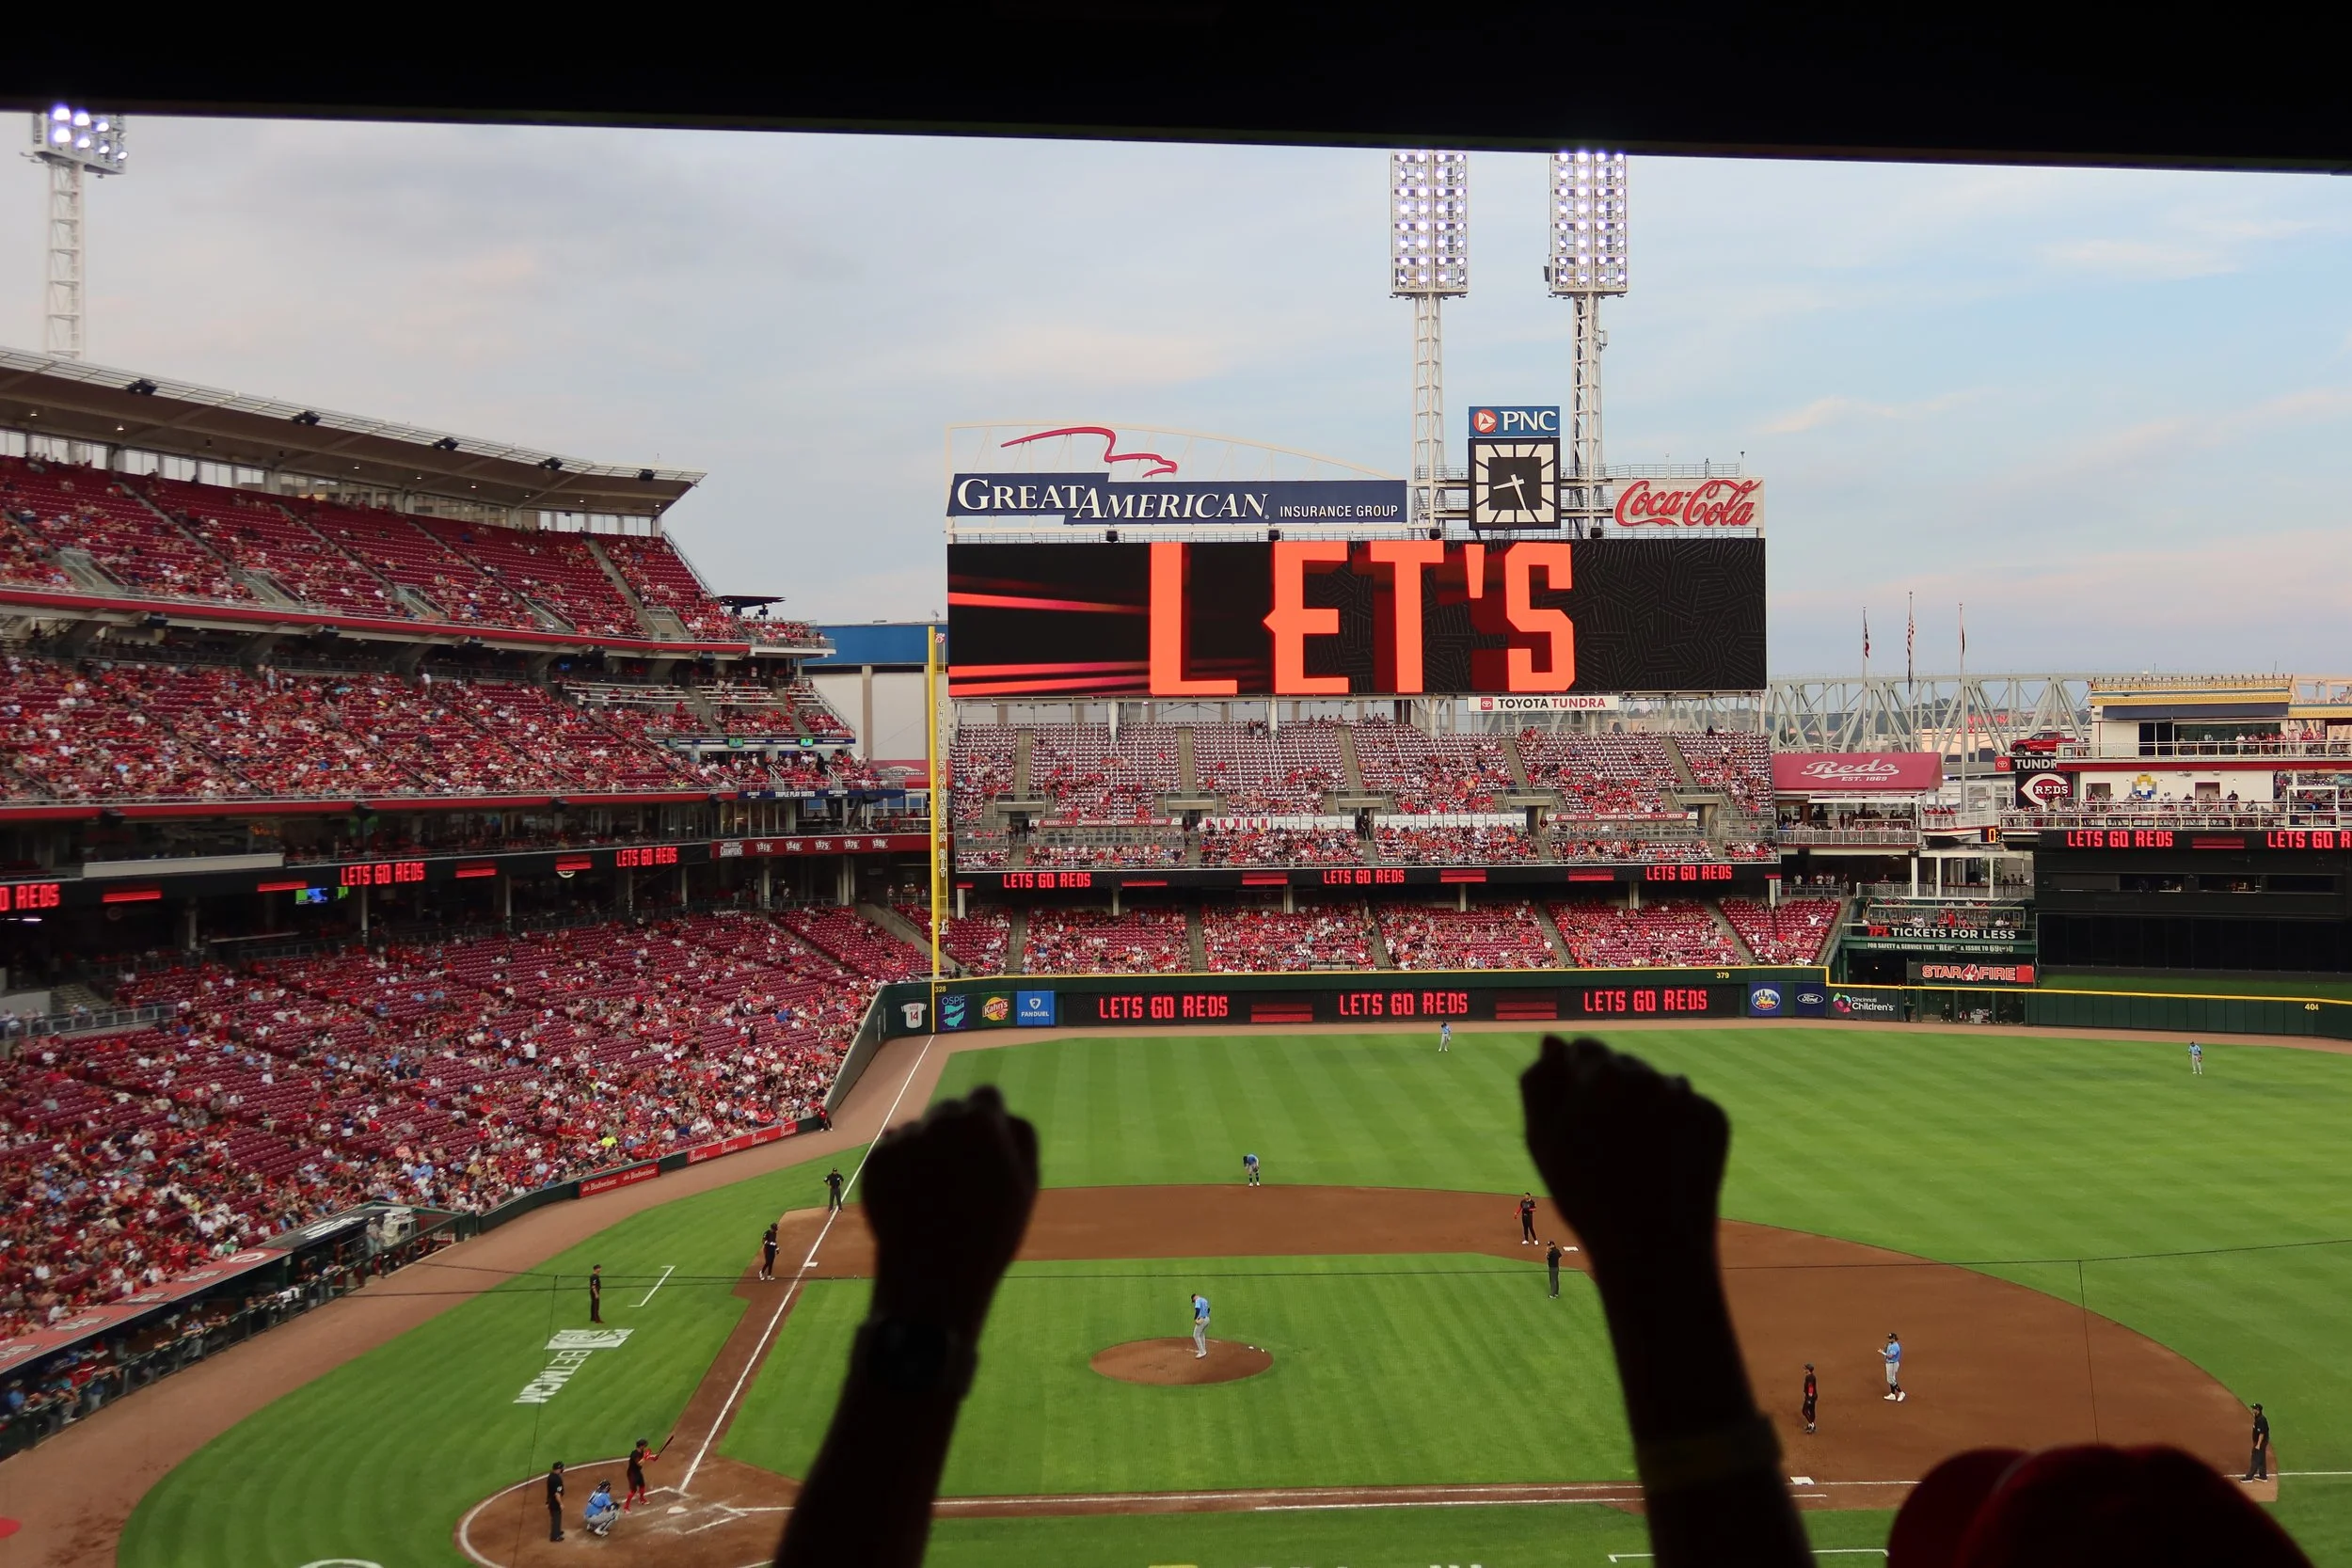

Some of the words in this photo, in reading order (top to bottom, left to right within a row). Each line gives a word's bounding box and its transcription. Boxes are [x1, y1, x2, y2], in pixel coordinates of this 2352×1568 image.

[1502, 411, 1557, 432] PNC
[957, 478, 1087, 511] GREAT
[1073, 490, 1269, 519] AMERICAN
[1279, 506, 1352, 517] INSURANCE
[1356, 505, 1398, 517] GROUP
[1614, 479, 1762, 527] Coca-Cola
[1150, 540, 1575, 695] LET'S
[1499, 698, 1549, 708] TOYOTA
[1551, 698, 1606, 708] TUNDRA
[1800, 758, 1899, 779] Reds
[2015, 759, 2058, 769] TUNDR
[2035, 785, 2069, 795] REDS
[2067, 831, 2104, 847] LETS
[2108, 832, 2129, 847] GO
[2135, 831, 2173, 847] REDS
[2267, 832, 2306, 848] LETS
[2312, 832, 2334, 849] GO
[617, 849, 639, 866] LETS
[642, 848, 653, 865] GO
[656, 847, 677, 863] REDS
[341, 865, 372, 886] LETS
[374, 864, 391, 884] GO
[395, 863, 424, 882] REDS
[1003, 874, 1034, 889] LETS
[1038, 873, 1055, 889] GO
[1060, 873, 1091, 888] REDS
[1324, 870, 1352, 884] LETS
[1356, 870, 1372, 884] GO
[1376, 870, 1405, 883] REDS
[1646, 866, 1676, 881] LETS
[1680, 866, 1697, 881] GO
[1702, 865, 1732, 880] REDS
[16, 884, 59, 910] REDS
[1891, 927, 1947, 938] TICKETS
[1951, 928, 1979, 939] FOR
[1983, 929, 2016, 940] LESS
[1922, 965, 1961, 979] STAR
[1979, 967, 2016, 981] FIRE
[984, 1001, 1009, 1015] Kahn's
[1099, 997, 1143, 1019] LETS
[1150, 997, 1175, 1019] GO
[1183, 996, 1229, 1018] REDS
[1340, 994, 1383, 1016] LETS
[1390, 993, 1415, 1016] GO
[1422, 993, 1468, 1014] REDS
[1584, 991, 1626, 1012] LETS
[1632, 990, 1656, 1012] GO
[1663, 990, 1708, 1011] REDS
[1851, 1003, 1894, 1011] Children's
[910, 1011, 918, 1021] 14
